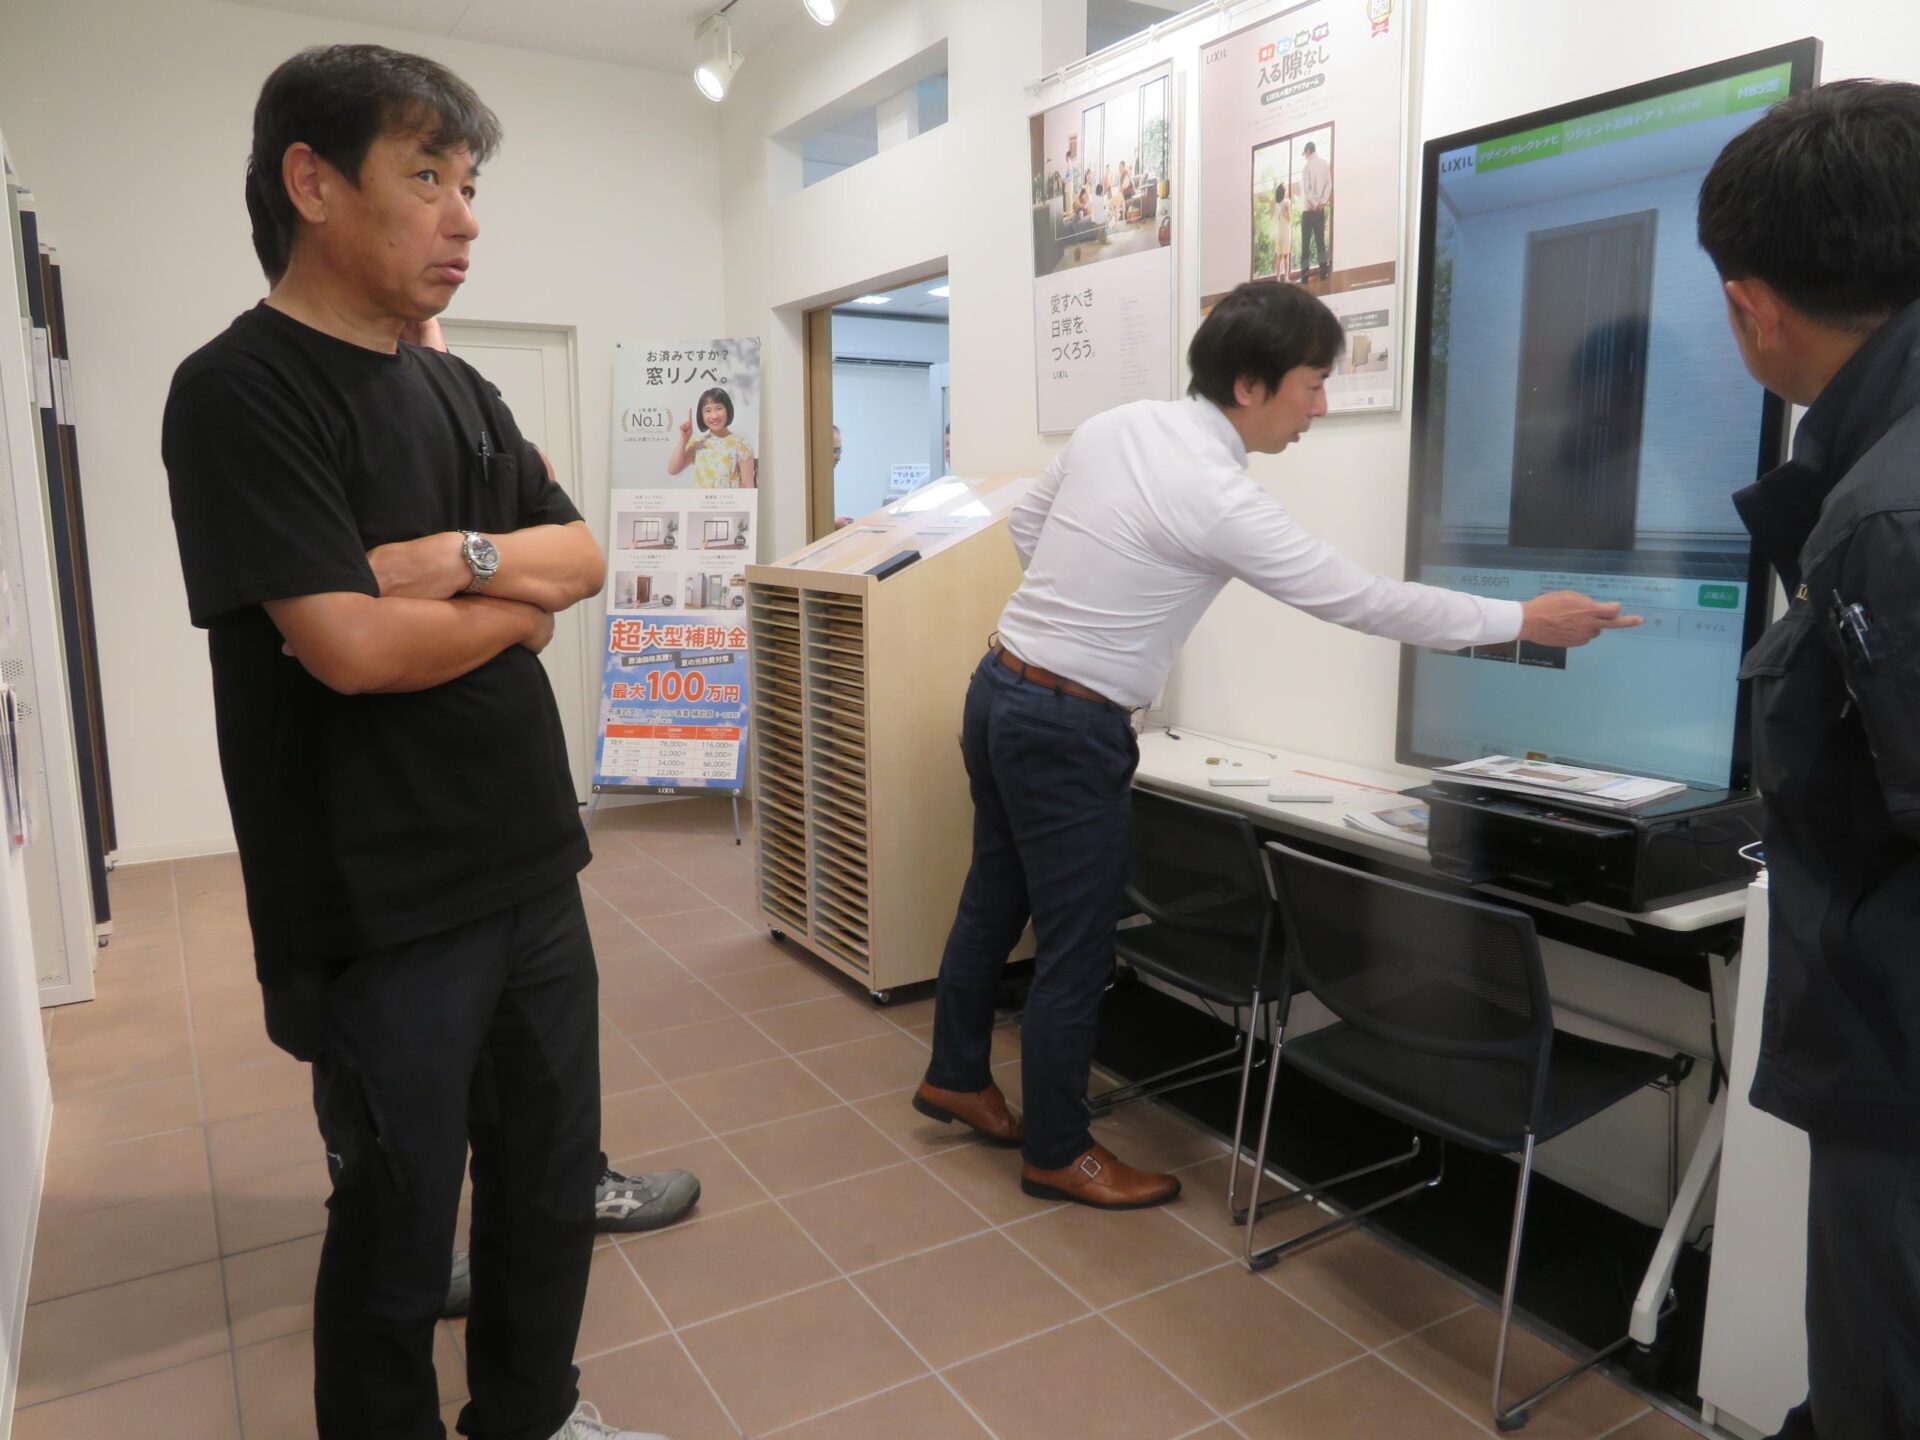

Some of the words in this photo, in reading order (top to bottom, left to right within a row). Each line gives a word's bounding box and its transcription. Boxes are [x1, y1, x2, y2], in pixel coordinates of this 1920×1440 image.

[1206, 49, 1227, 64] LIXIL
[1478, 133, 1560, 163] デザインセレクトナビ
[1441, 156, 1473, 174] LIXIL
[1051, 288, 1093, 315] 愛すべき
[1051, 315, 1088, 339] 日常を、
[646, 349, 729, 362] お済みですか？
[1051, 340, 1096, 362] つくろう。
[646, 367, 729, 386] 窓リノベ。
[1053, 370, 1069, 380] LIXIL
[632, 413, 664, 427] No.1
[1460, 575, 1510, 588] 495,900円
[610, 619, 748, 652] 超大型補助金
[612, 671, 741, 702] 最大100万円
